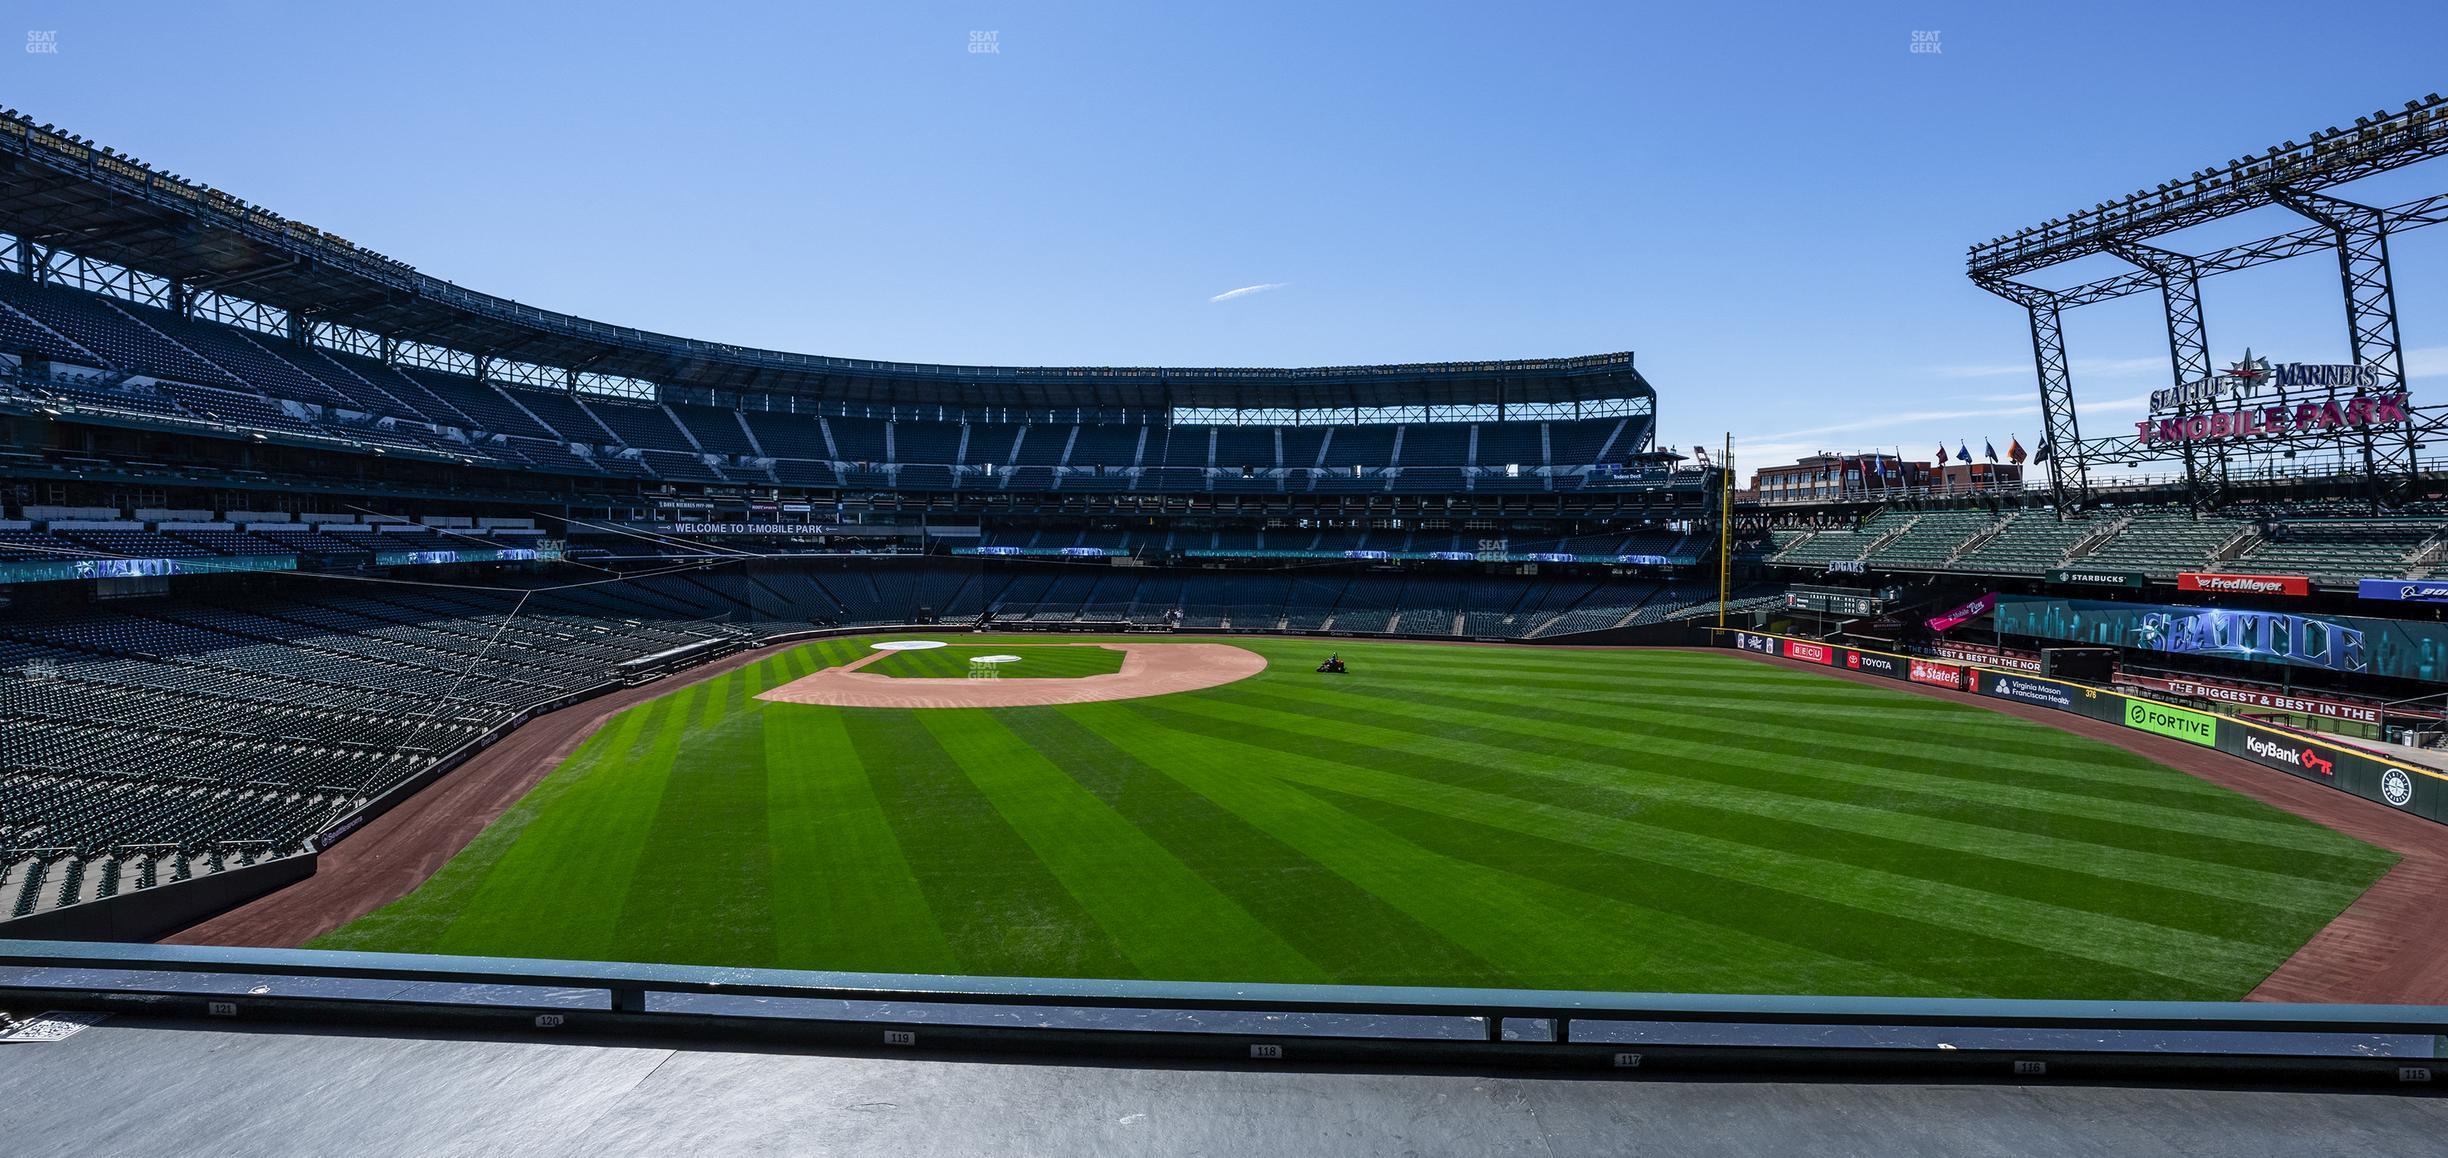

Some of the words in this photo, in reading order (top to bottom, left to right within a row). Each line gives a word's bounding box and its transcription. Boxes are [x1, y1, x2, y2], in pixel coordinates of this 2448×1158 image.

[2150, 376, 2228, 412] SEATTLE
[2275, 362, 2379, 388] MARINERS
[2135, 405, 2288, 444] T-MOBILE
[2296, 391, 2412, 429] PARK
[675, 523, 727, 533] WELCOME
[730, 524, 744, 533] TO
[748, 524, 794, 534] T-MOBILE
[796, 525, 822, 534] PARK
[2071, 574, 2124, 583] STARBUCKS
[1794, 645, 1821, 658] BECU
[1861, 657, 1892, 670] TOYOTA
[1966, 653, 1987, 663] BEST
[1989, 656, 1999, 665] IN
[2001, 658, 2018, 668] THE
[2012, 681, 2038, 691] Virginia
[2038, 685, 2061, 695] Mason
[2085, 689, 2097, 699] 376
[2012, 688, 2048, 701] Franciscan
[2048, 695, 2069, 705] Health
[2197, 686, 2256, 703] BIGGEST
[2260, 696, 2270, 706] &
[2275, 698, 2315, 712] BEST
[2320, 704, 2337, 715] IN
[2341, 706, 2376, 721] THE
[2149, 712, 2209, 737] FORTIVE
[2247, 736, 2300, 765] KeyBank
[215, 1004, 233, 1014] 121
[542, 1016, 559, 1025] 120
[892, 1033, 909, 1043] 119
[1258, 1047, 1276, 1057] 118
[1622, 1056, 1640, 1064] 117
[2022, 1062, 2040, 1073] 116
[2406, 1070, 2425, 1079] 115
